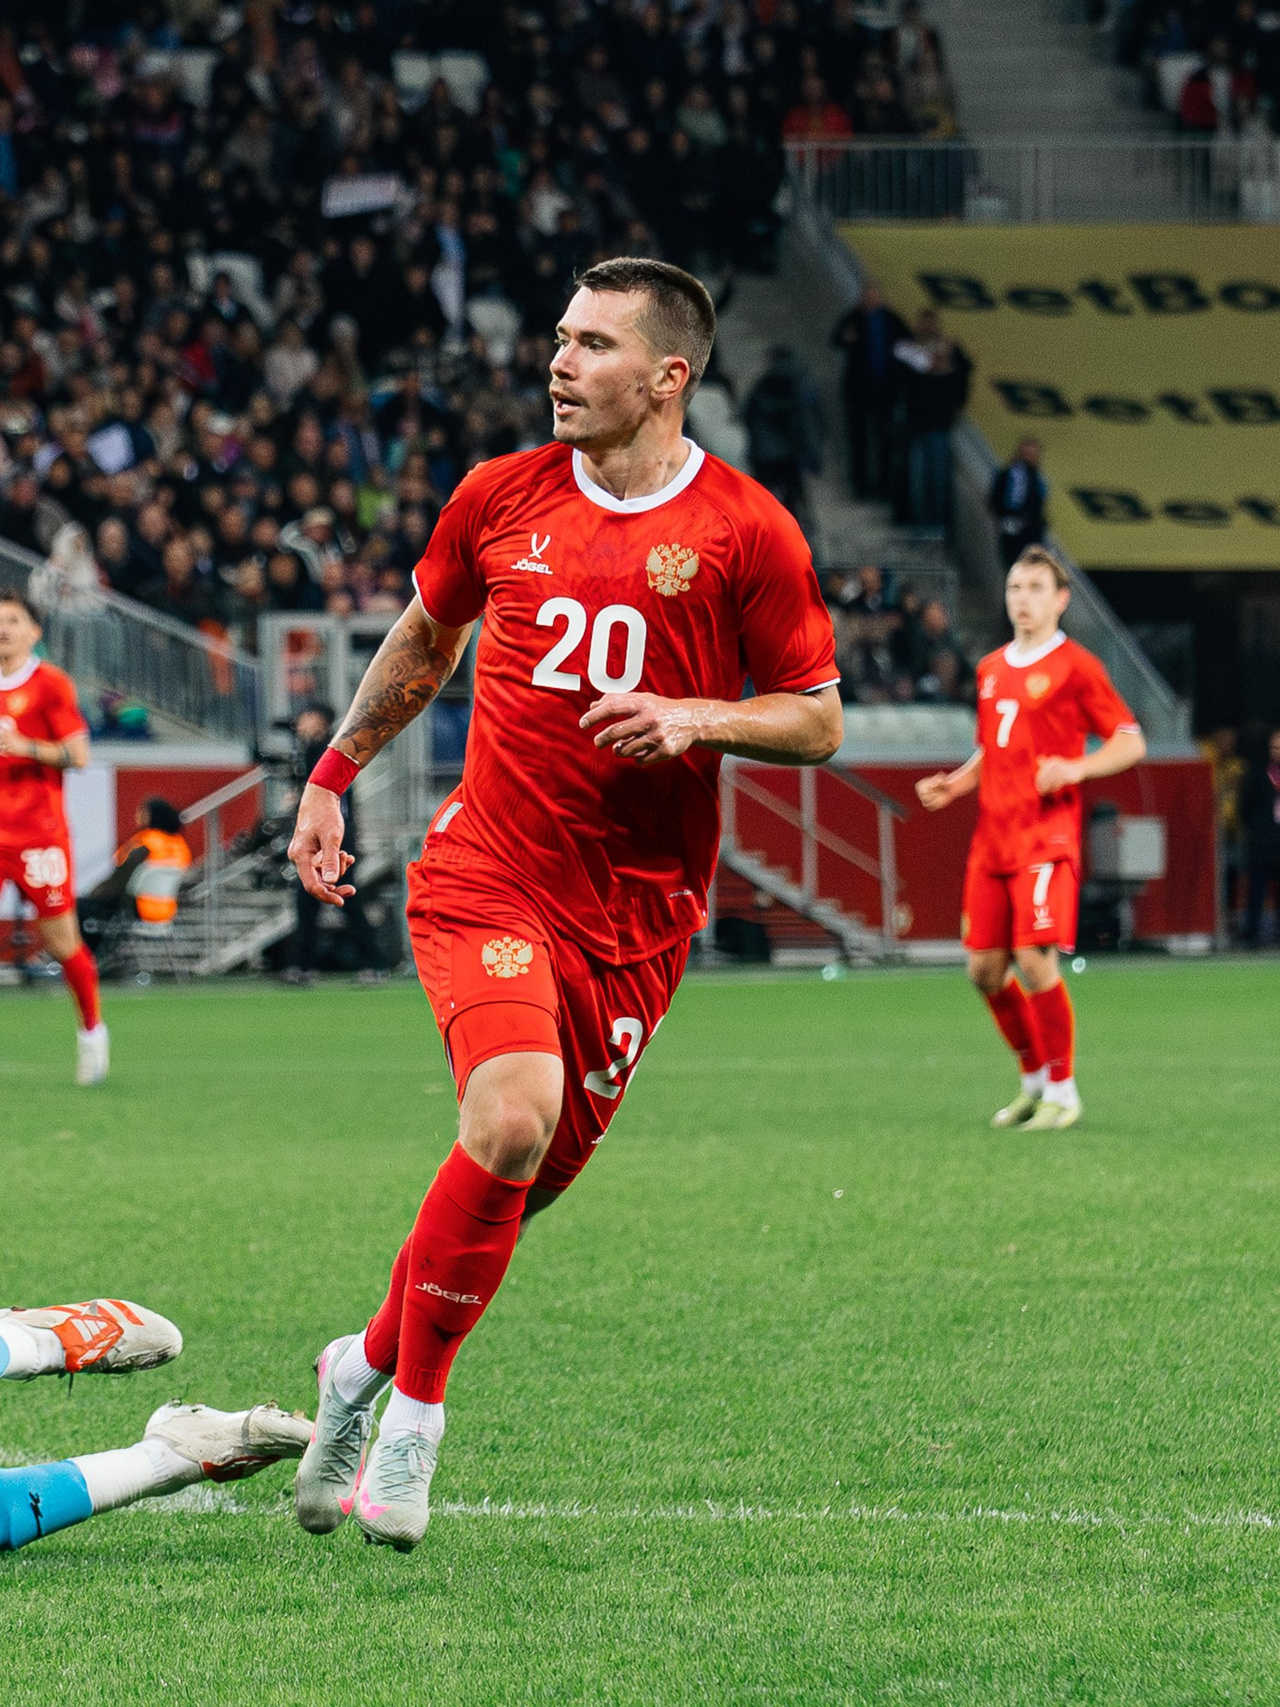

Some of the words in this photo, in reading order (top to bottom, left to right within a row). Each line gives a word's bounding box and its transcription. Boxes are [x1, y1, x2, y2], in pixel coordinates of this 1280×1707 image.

[510, 558, 553, 576] JÖGEL
[531, 596, 647, 694] 20
[995, 699, 1020, 749] 7
[20, 845, 69, 889] 30
[1027, 862, 1055, 907] 7
[583, 1016, 664, 1100] 2
